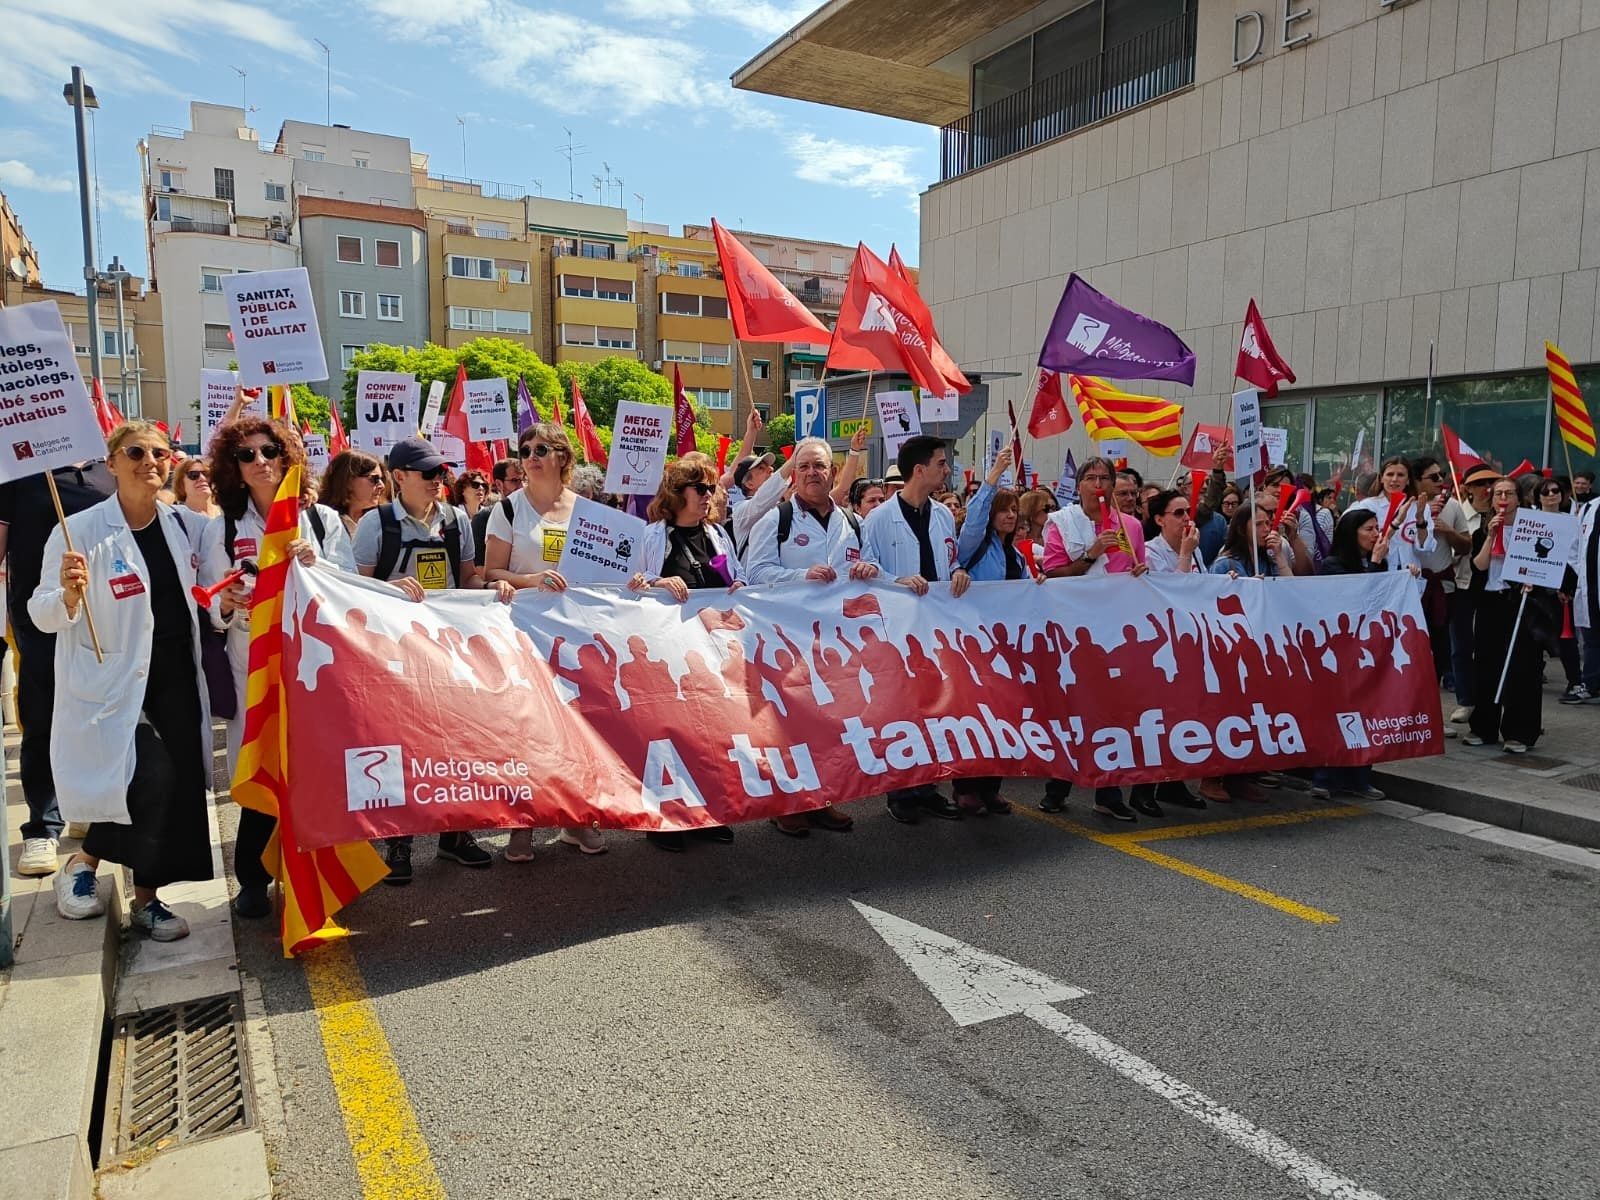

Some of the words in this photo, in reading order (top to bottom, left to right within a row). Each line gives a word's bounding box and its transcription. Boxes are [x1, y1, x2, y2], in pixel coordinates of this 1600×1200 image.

[1232, 0, 1312, 68] DE
[237, 288, 294, 302] SANITAT,
[242, 317, 247, 327] I
[250, 315, 269, 326] DE
[245, 323, 307, 339] QUALITAT
[0, 357, 59, 375] tòlegs,
[366, 383, 406, 391] CONVENI
[30, 388, 65, 403] som
[208, 392, 236, 400] jubila
[365, 402, 405, 422] JA!
[801, 395, 819, 436] P
[624, 415, 661, 427] METGE
[623, 426, 664, 440] CANSAT,
[32, 438, 62, 449] Metges
[620, 437, 648, 445] PACIENT
[35, 444, 73, 456] Catalunya
[620, 444, 660, 453] MALTRACTAT
[578, 517, 609, 535] Tanta
[1518, 519, 1546, 529] Pitjor
[575, 529, 614, 547] espera
[1516, 526, 1554, 538] atenció
[573, 538, 594, 550] ens
[570, 547, 628, 573] desespera
[1510, 553, 1563, 567] sobresaturació
[1365, 715, 1414, 731] Metges
[1415, 712, 1429, 725] de
[1371, 729, 1432, 746] Catalunya
[641, 739, 707, 814] A
[728, 734, 821, 797] tu
[842, 703, 1055, 776] també
[411, 757, 498, 781] Metges
[503, 757, 529, 776] de
[413, 781, 533, 806] Catalunya
